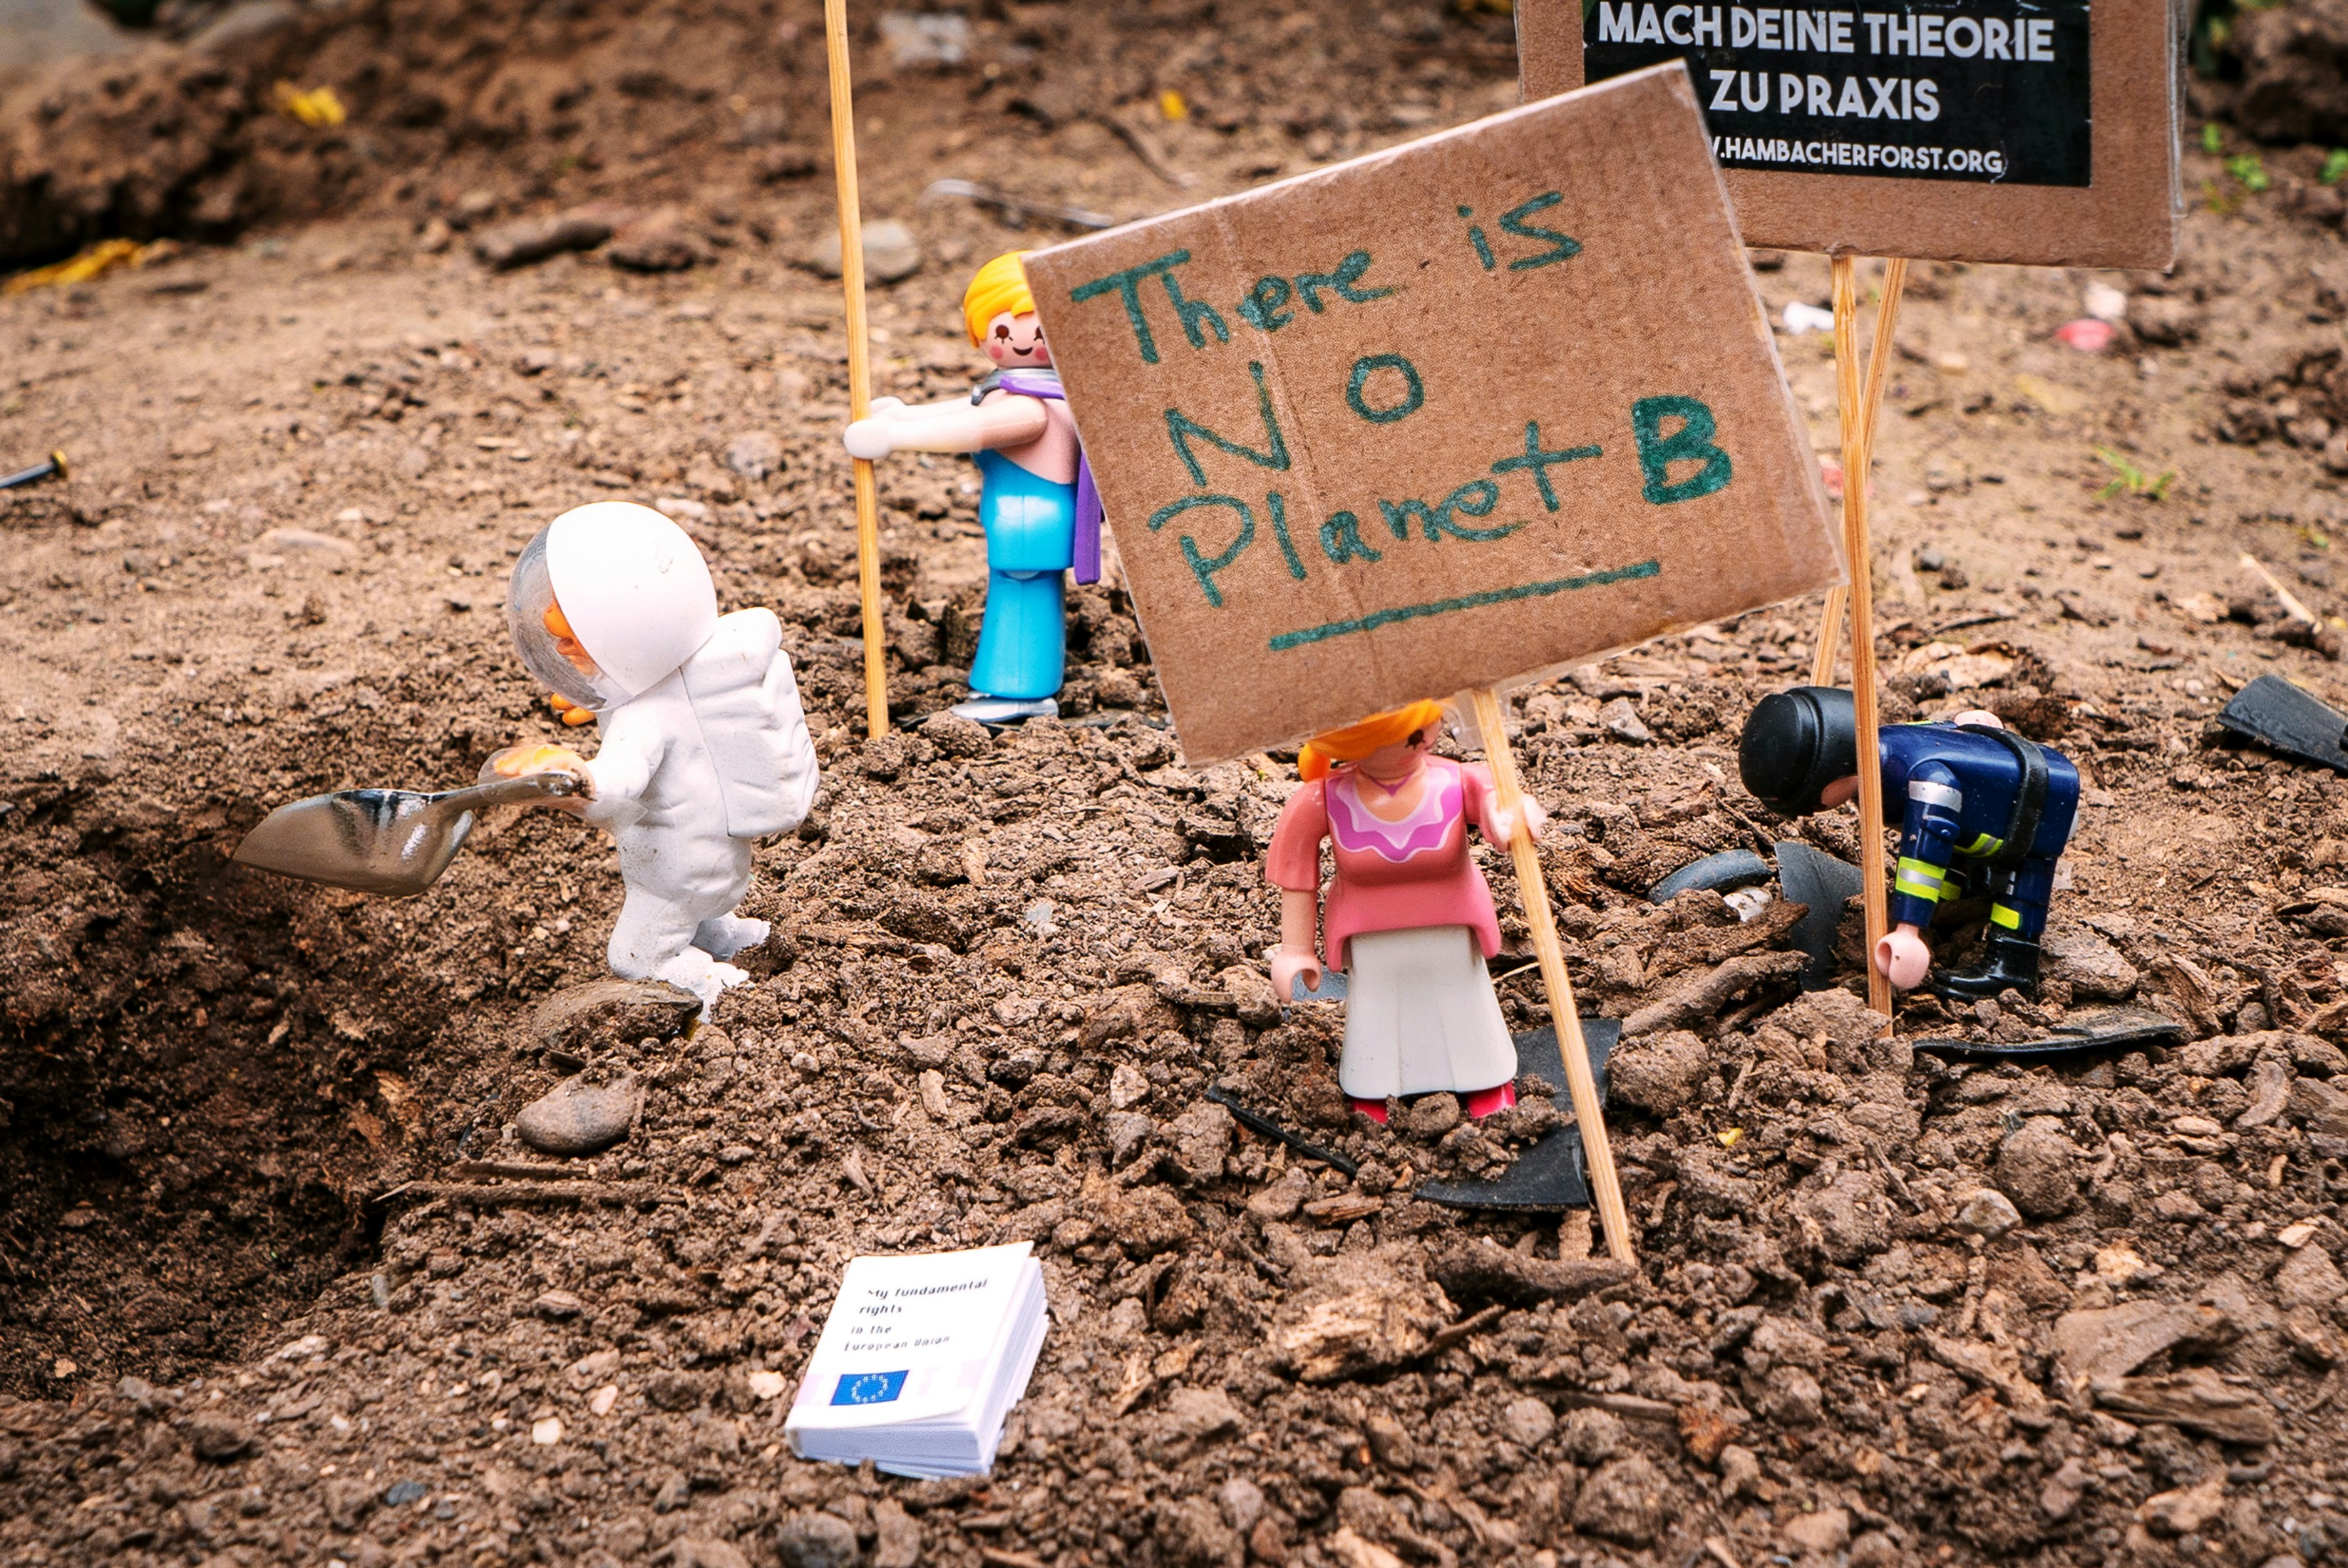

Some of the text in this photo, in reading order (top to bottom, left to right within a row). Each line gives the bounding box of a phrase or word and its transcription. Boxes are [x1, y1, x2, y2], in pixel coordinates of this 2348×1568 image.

[1598, 1, 2055, 62] MACH DEINE THEORIE
[1709, 69, 1940, 122] ZU PRAXIS
[1071, 249, 1399, 364] There
[1148, 394, 1733, 608] Planet B
[867, 1278, 989, 1301] My fundamental
[858, 1303, 903, 1317] rights
[843, 1340, 907, 1352] European
[850, 1324, 892, 1335] in the
